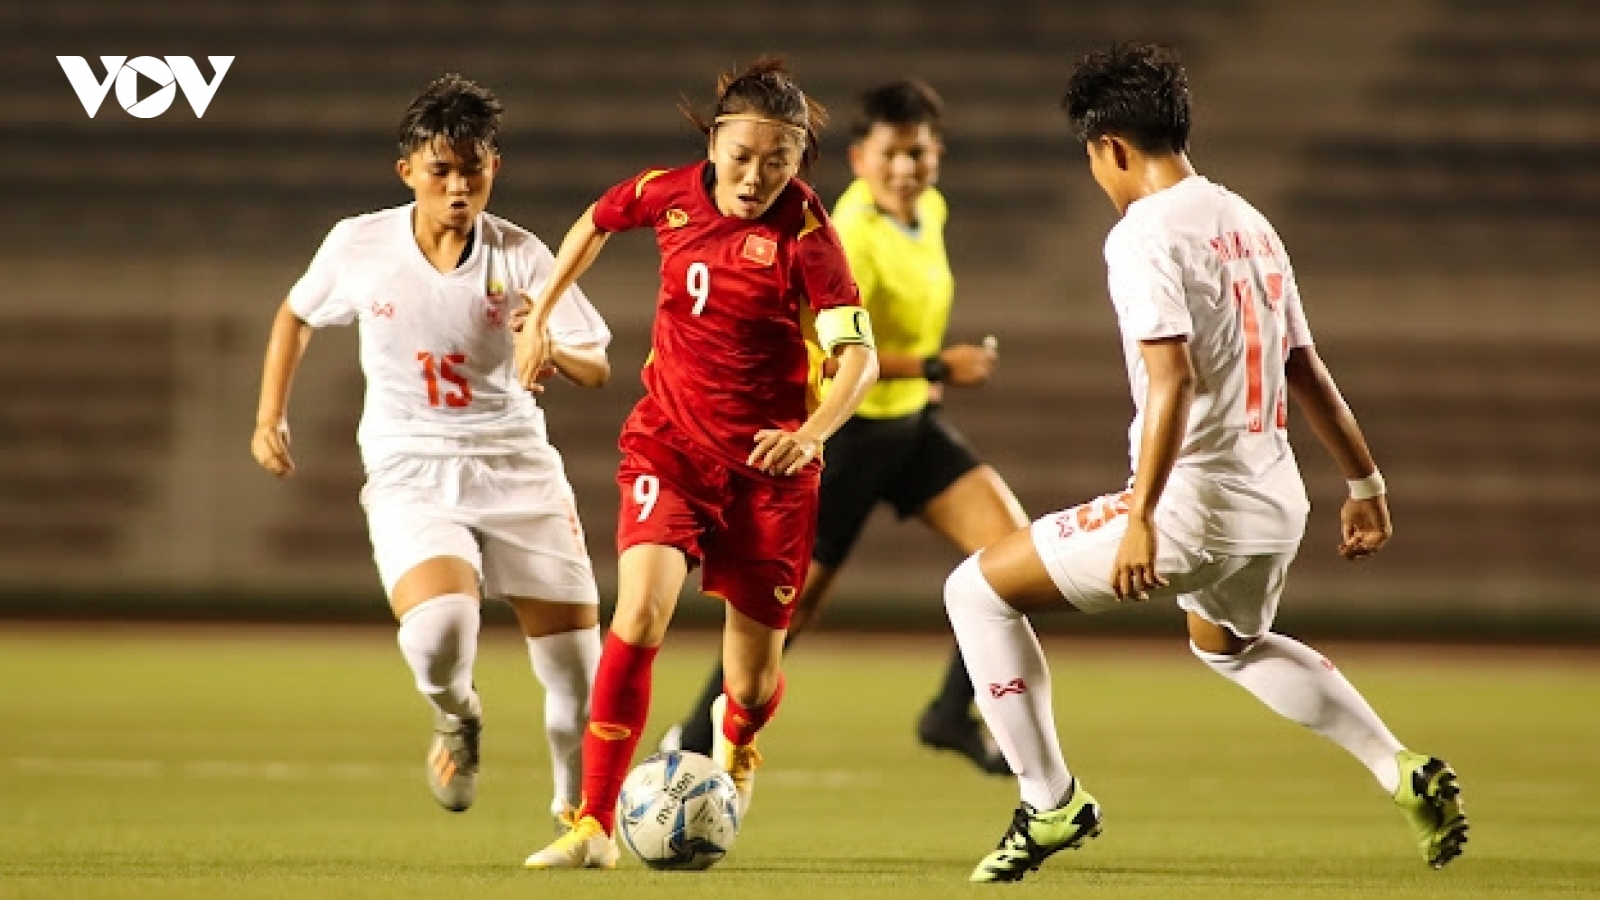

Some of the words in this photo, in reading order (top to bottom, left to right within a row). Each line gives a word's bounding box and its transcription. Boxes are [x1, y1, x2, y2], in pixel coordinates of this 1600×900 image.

[685, 263, 710, 316] 9
[415, 352, 473, 407] 15
[632, 475, 660, 522] 9
[656, 772, 696, 826] molten
